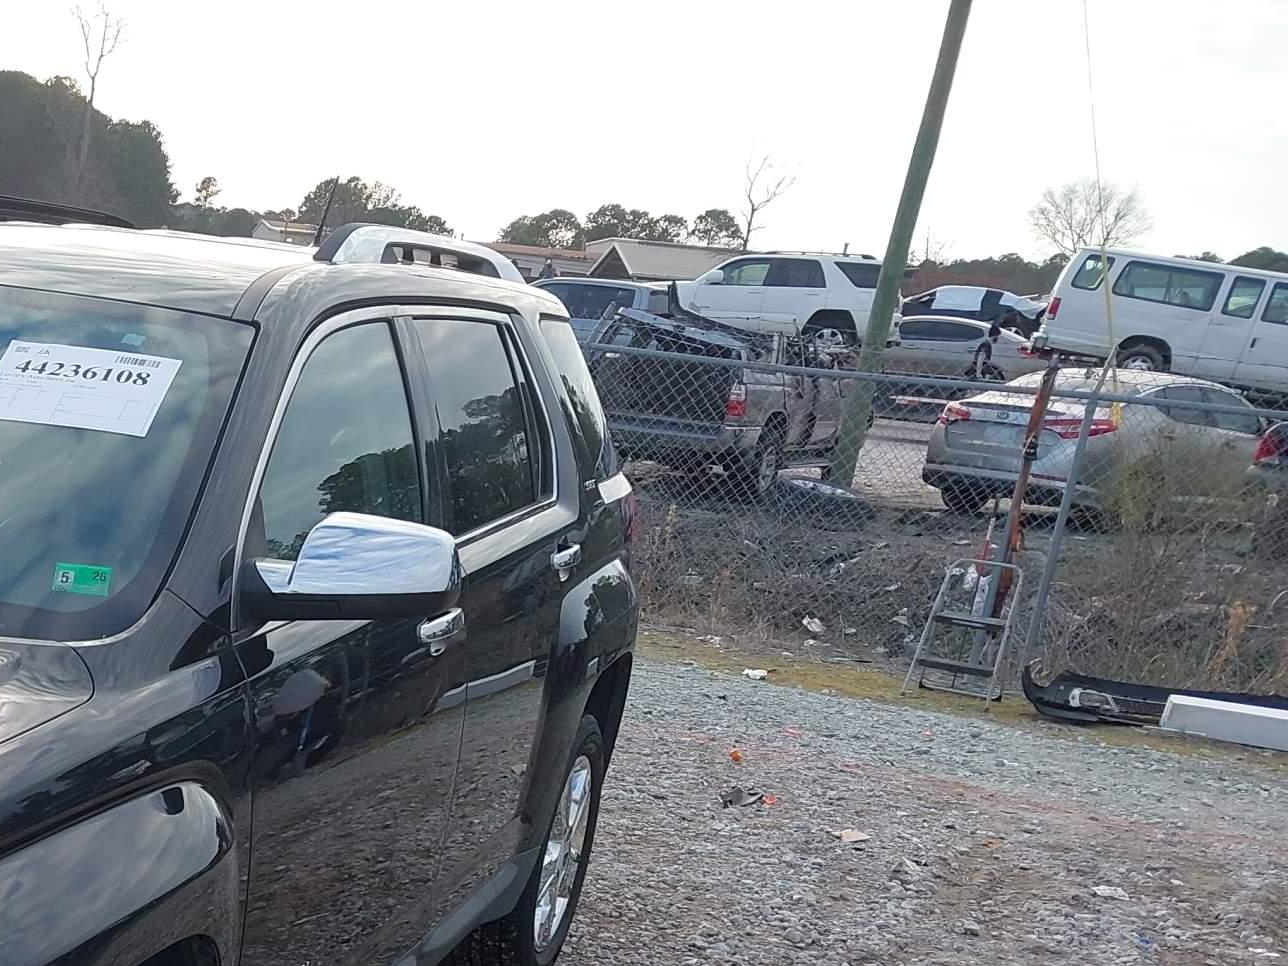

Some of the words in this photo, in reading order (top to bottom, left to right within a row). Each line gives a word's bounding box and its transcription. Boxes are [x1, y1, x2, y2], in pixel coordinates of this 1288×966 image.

[13, 359, 151, 386] 44236108
[60, 571, 70, 584] 5
[92, 571, 107, 582] 26
